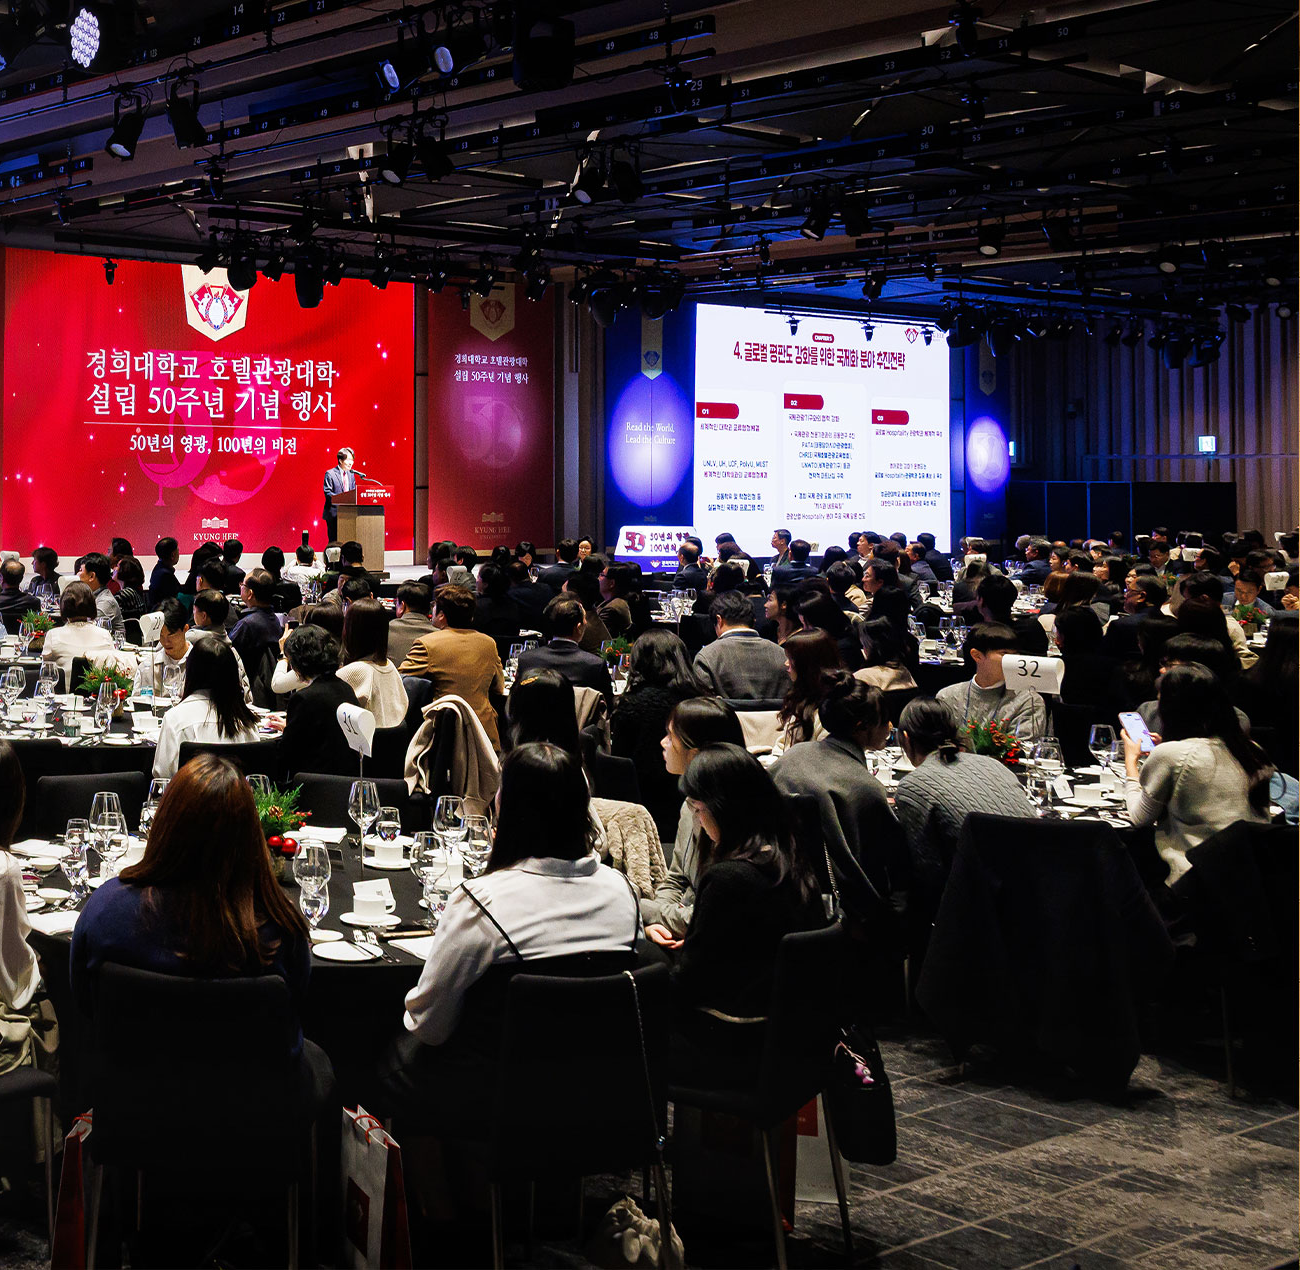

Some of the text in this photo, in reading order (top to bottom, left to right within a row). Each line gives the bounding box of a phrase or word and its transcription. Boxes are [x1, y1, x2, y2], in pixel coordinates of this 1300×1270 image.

[234, 3, 244, 16] 14
[316, 1, 325, 11] 21
[278, 12, 285, 22] 22
[232, 24, 240, 35] 23
[694, 20, 704, 30] 47
[649, 31, 659, 40] 48
[1057, 27, 1069, 37] 50
[193, 36, 201, 46] 24
[606, 41, 615, 51] 49
[998, 39, 1009, 49] 51
[940, 50, 952, 60] 52
[884, 61, 896, 71] 53
[487, 69, 495, 79] 48
[29, 80, 36, 91] 24
[450, 78, 459, 87] 49
[691, 80, 703, 92] 29
[783, 80, 793, 90] 50
[741, 88, 750, 98] 51
[1225, 92, 1237, 102] 55
[691, 98, 701, 107] 52
[1169, 101, 1181, 111] 56
[320, 108, 328, 117] 49
[654, 106, 662, 114] 53
[1116, 110, 1125, 120] 57
[261, 121, 268, 129] 47
[533, 128, 540, 136] 51
[921, 125, 934, 136] 30
[1015, 127, 1025, 135] 54
[492, 136, 499, 144] 52
[972, 134, 981, 142] 55
[461, 142, 468, 150] 53
[920, 141, 929, 151] 56
[878, 149, 886, 157] 57
[334, 165, 341, 173] 52
[1112, 167, 1121, 175] 60
[1068, 173, 1076, 181] 61
[686, 179, 694, 187] 57
[948, 188, 957, 196] 59
[454, 353, 488, 365] 경희대학교
[733, 341, 906, 371] 4. 글로벌 평판도 강화를 위한 국제화 분야 추진전략
[86, 348, 337, 388] 경희대학교 호텔관광대학
[453, 370, 529, 385] 설립 50주년 기념 행사
[86, 382, 336, 423] 설립 50주년 기념 행사
[626, 422, 675, 433] Read the World,
[129, 434, 297, 455] 50년의 영광, 100년의 비전
[625, 434, 641, 443] Lead
[653, 435, 676, 445] Culture
[193, 532, 237, 541] KYUNG HEE
[1018, 659, 1042, 678] 32
